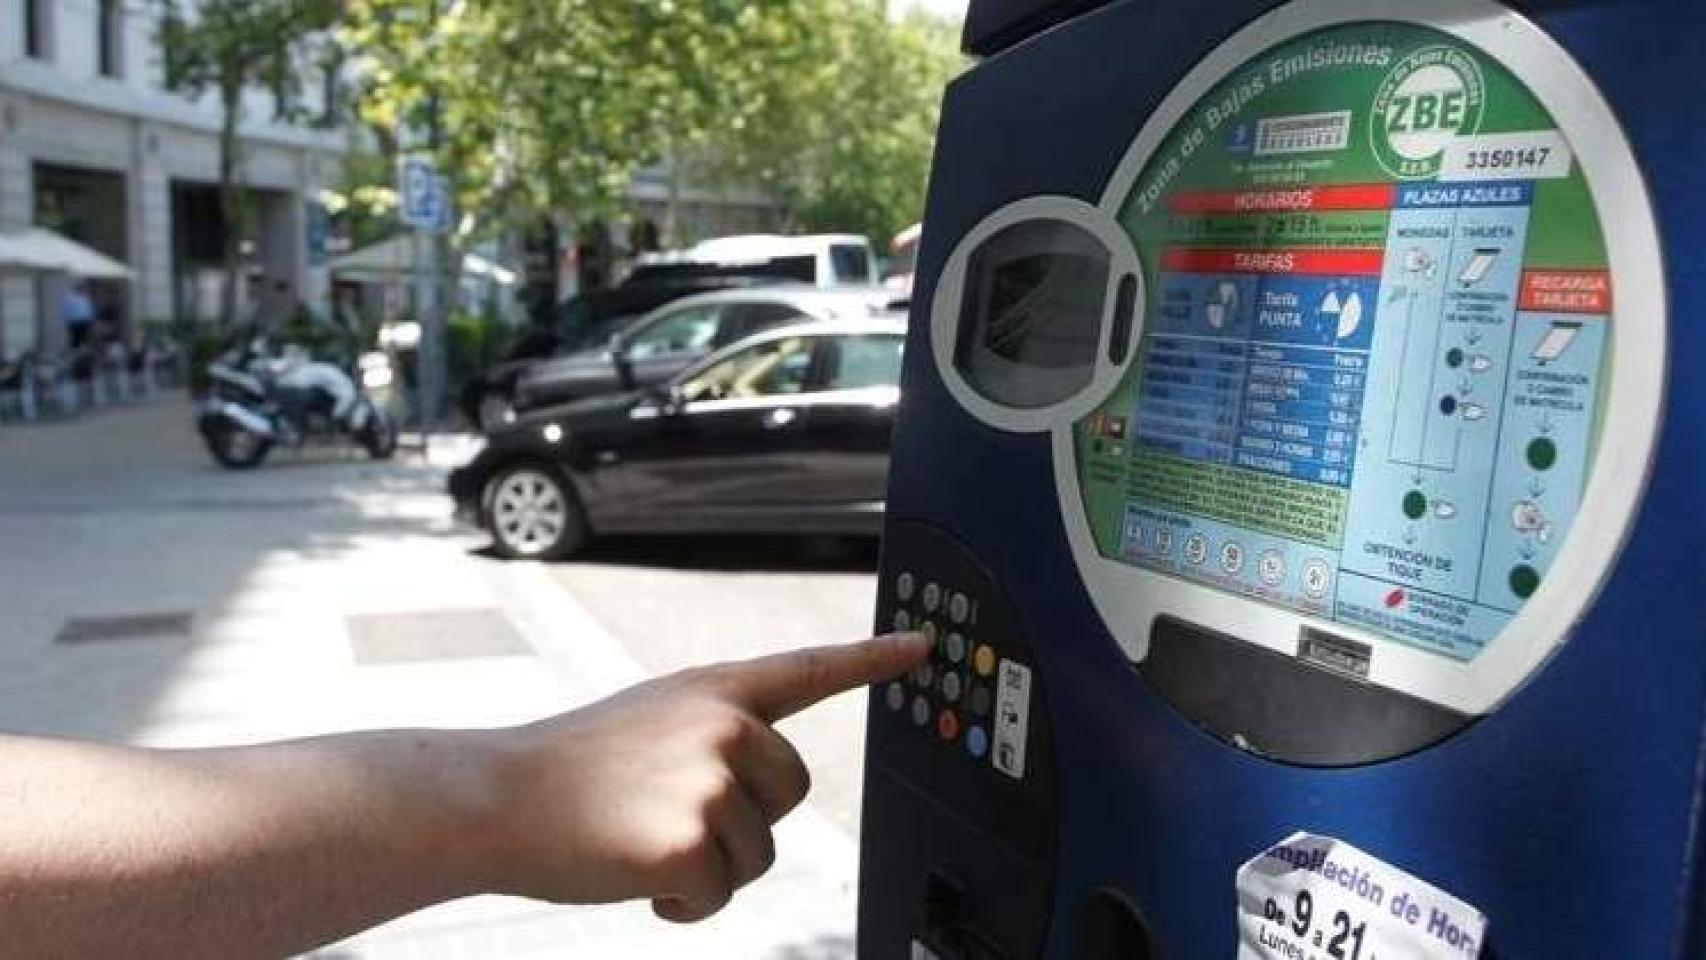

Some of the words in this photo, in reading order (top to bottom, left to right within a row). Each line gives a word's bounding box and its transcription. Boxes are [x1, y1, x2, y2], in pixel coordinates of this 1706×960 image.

[1390, 91, 1462, 132] ZBE
[1138, 157, 1181, 215] Zona
[1181, 127, 1205, 157] de
[1205, 74, 1266, 130] Bajas
[1270, 44, 1393, 84] Emisiones
[1465, 148, 1550, 169] 3350147
[1234, 191, 1314, 208] HORARIOS
[1402, 188, 1458, 204] PLAZAS
[1462, 186, 1522, 202] AZULES
[1462, 225, 1514, 238] TARJETA
[1234, 253, 1295, 271] TARIFAS
[1528, 274, 1604, 289] RECARGA
[1265, 291, 1298, 306] Tarifa
[1534, 291, 1600, 306] TARJETA
[1259, 310, 1302, 327] PUNTA
[1387, 561, 1422, 581] TIQUE
[1435, 556, 1453, 572] DE
[1264, 845, 1384, 907] mpliación
[1390, 892, 1421, 925] de
[1264, 897, 1286, 926] De
[1291, 889, 1313, 937] 9
[1313, 929, 1323, 947] a
[1327, 910, 1366, 960] 21
[1259, 924, 1304, 960] Lunes
